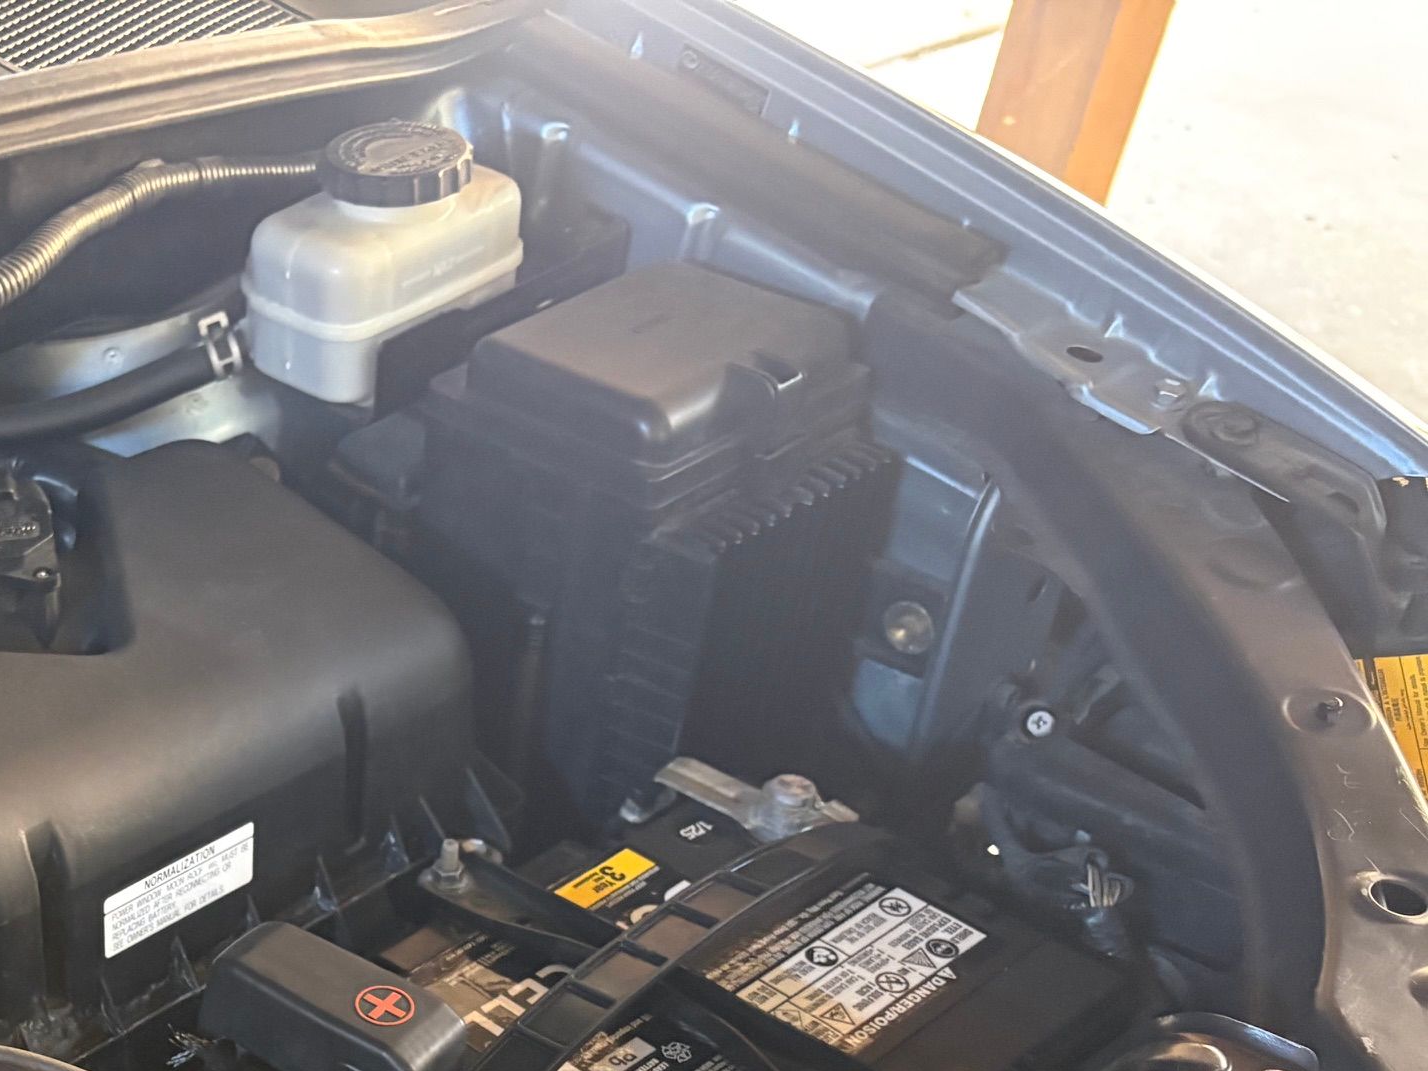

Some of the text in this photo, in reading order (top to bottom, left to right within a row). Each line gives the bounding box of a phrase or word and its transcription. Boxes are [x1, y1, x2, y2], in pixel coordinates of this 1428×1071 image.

[142, 844, 216, 889] NORMALIZATION
[600, 865, 626, 883] 3
[844, 976, 948, 1048] DANGER/POISON
